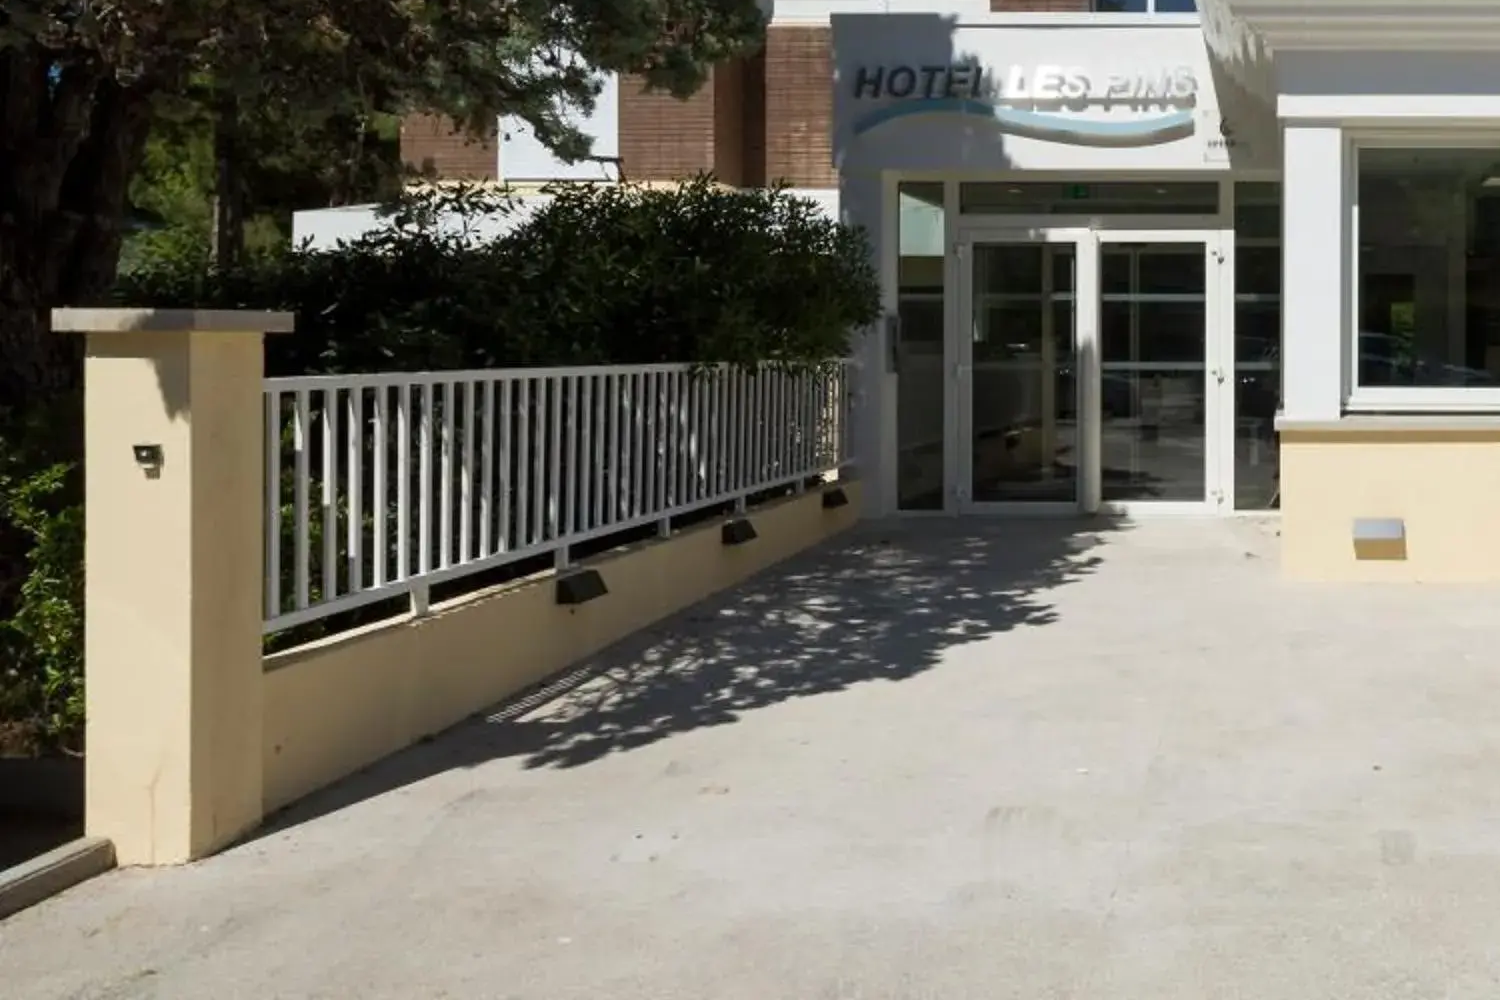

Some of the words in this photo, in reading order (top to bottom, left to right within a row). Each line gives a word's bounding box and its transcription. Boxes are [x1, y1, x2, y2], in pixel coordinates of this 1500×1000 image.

[854, 65, 991, 99] HOTEL
[1002, 64, 1091, 99] LES
[1104, 65, 1198, 100] PINS
